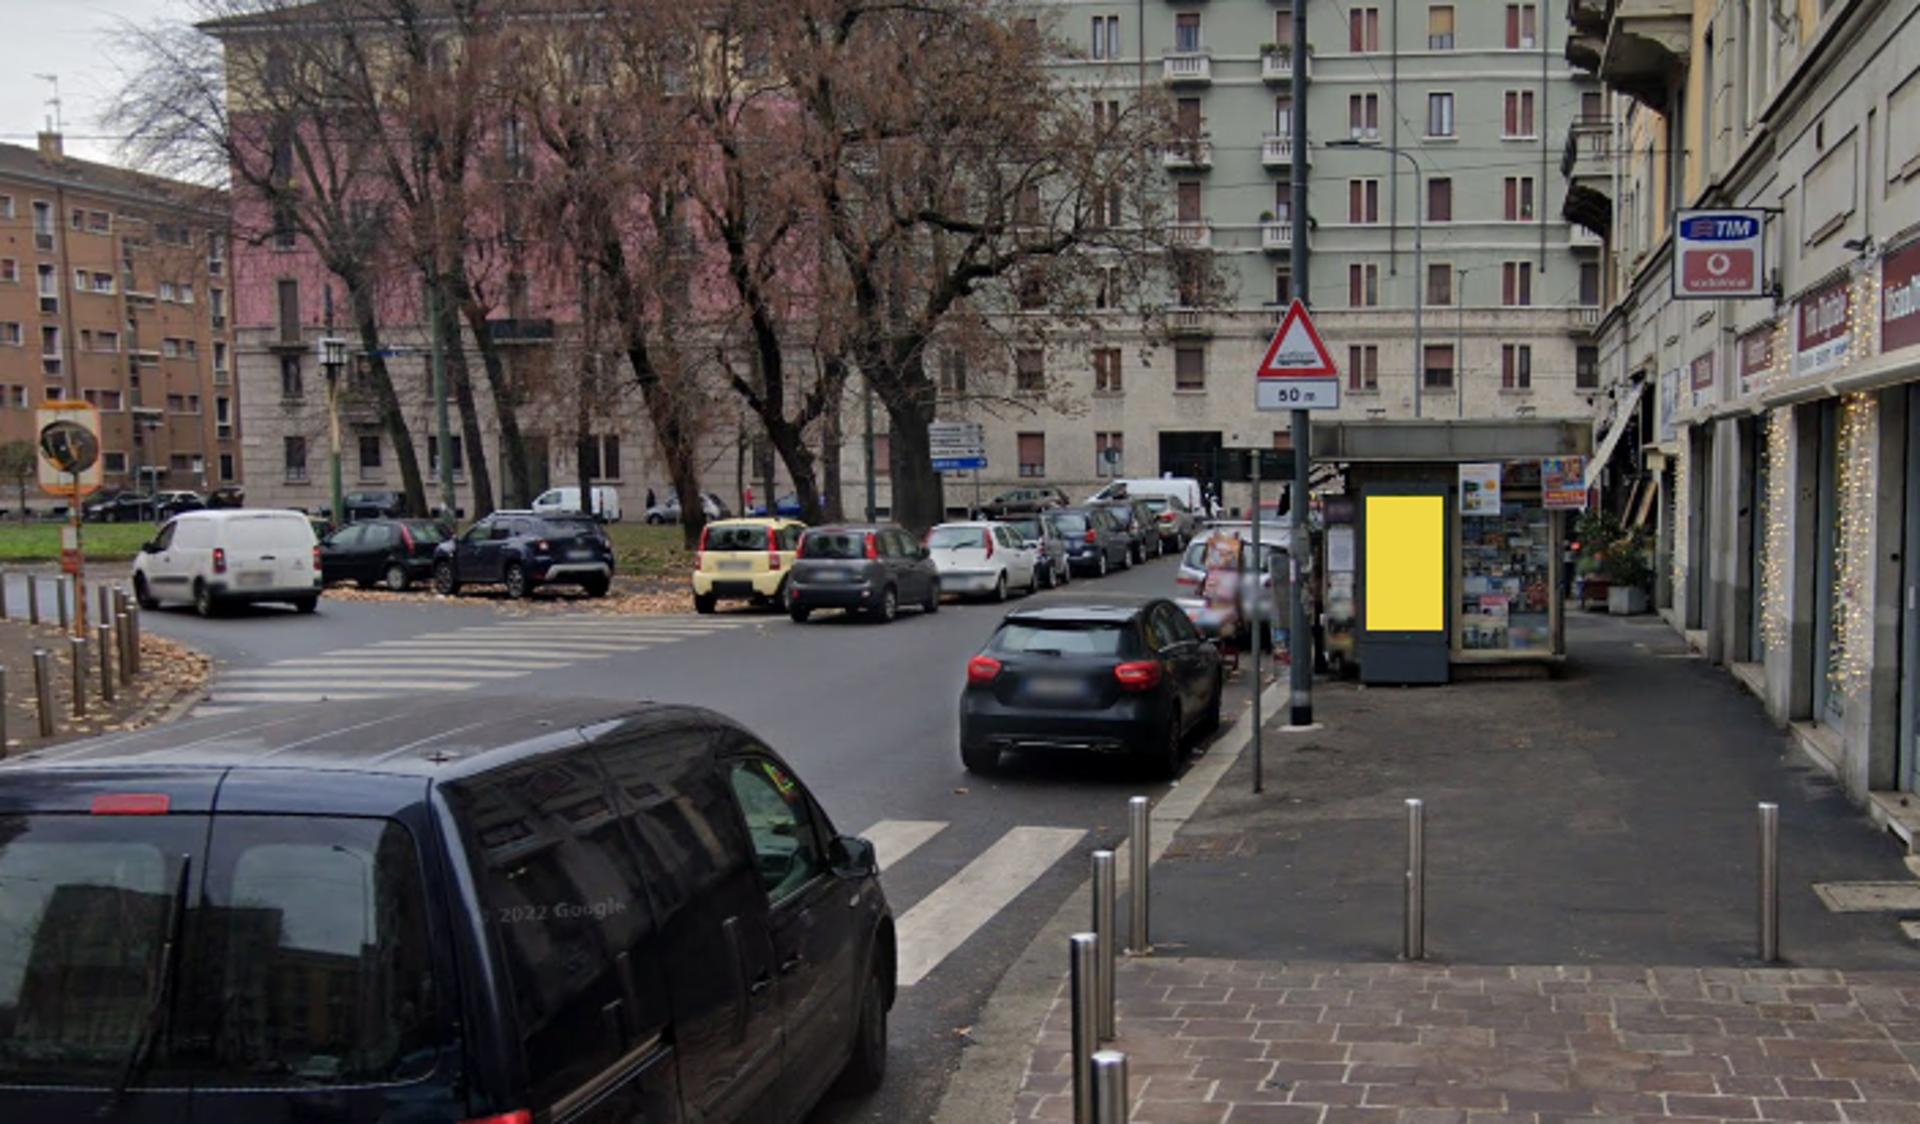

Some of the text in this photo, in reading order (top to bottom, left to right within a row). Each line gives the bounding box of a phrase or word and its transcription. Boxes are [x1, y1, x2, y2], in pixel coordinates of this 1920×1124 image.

[1716, 220, 1752, 238] TIM
[1278, 387, 1316, 402] 50 m
